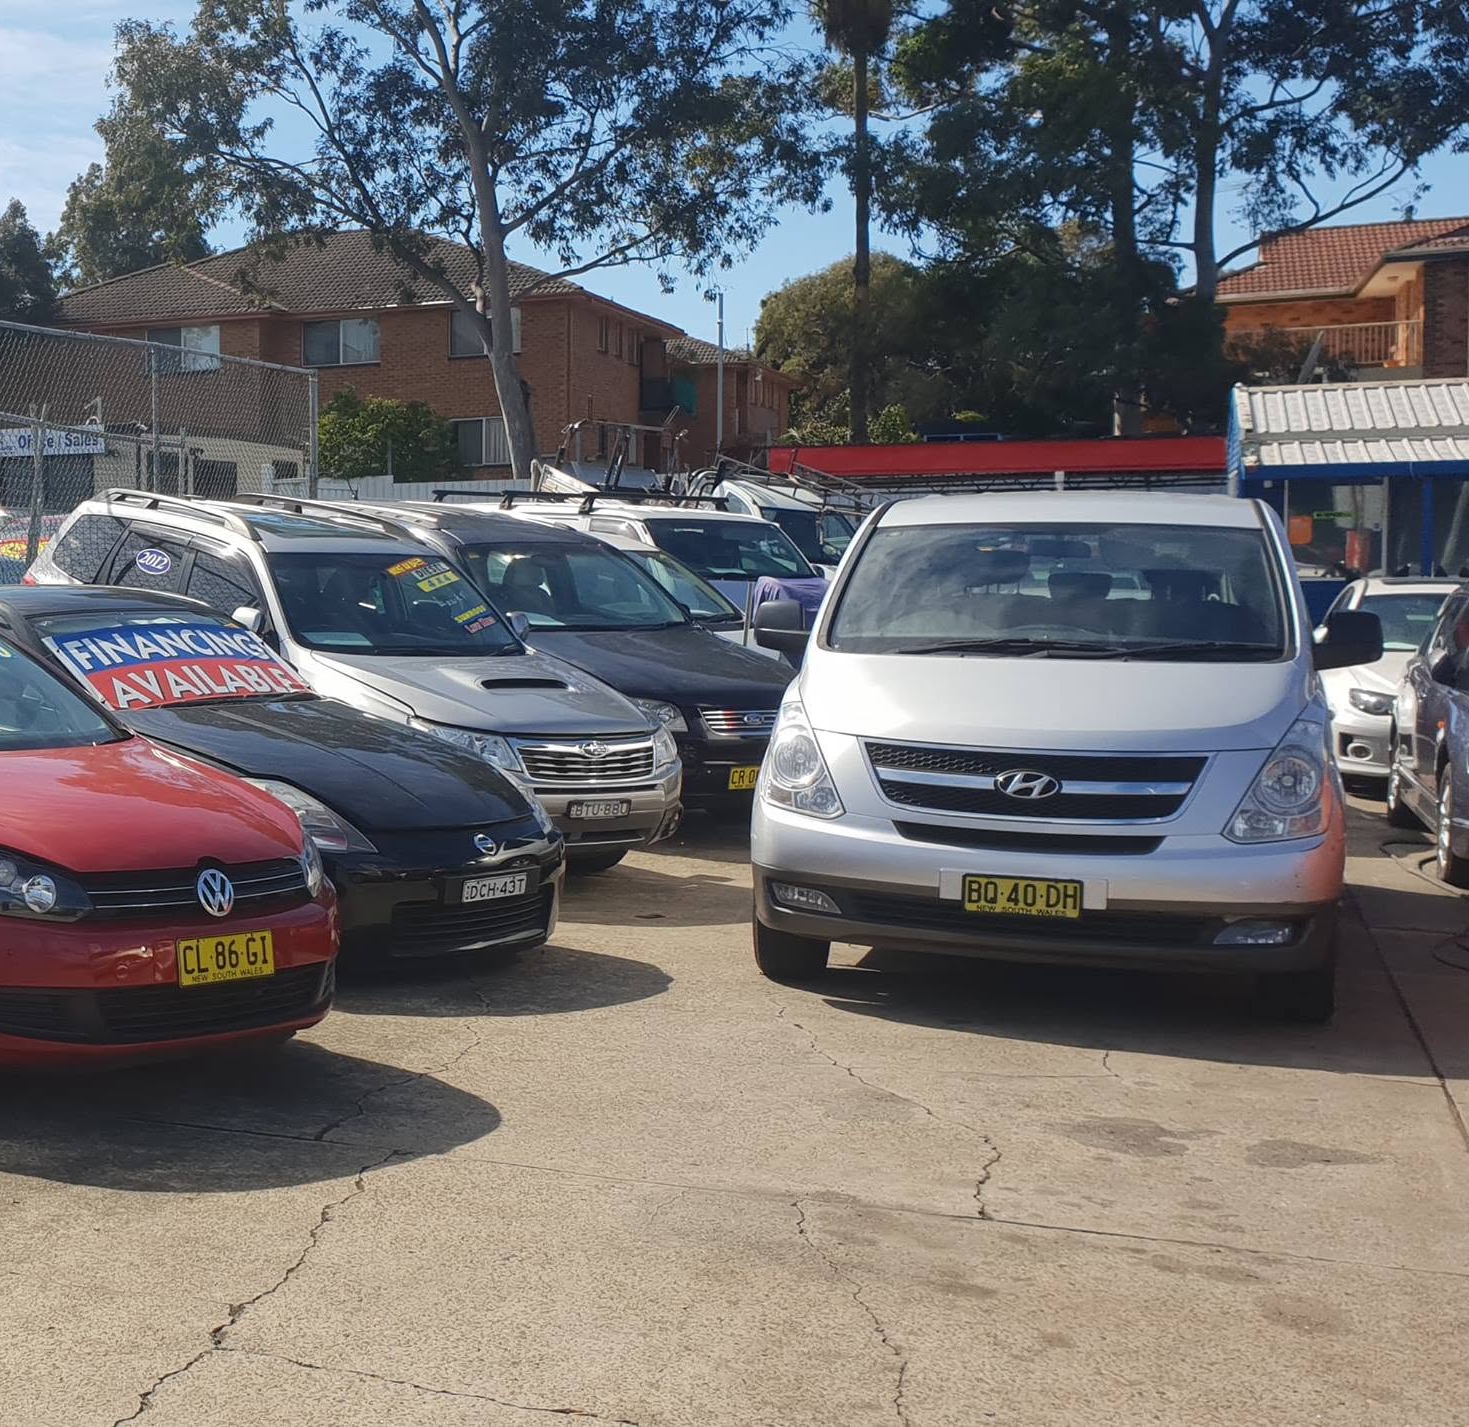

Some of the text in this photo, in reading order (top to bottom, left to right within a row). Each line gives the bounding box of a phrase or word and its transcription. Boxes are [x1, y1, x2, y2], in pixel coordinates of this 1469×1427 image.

[65, 432, 98, 447] Sales
[138, 551, 169, 570] 2012
[415, 562, 447, 579] DIESEL
[63, 629, 270, 670] FINANCING
[111, 664, 293, 709] AVAILABLE
[976, 904, 1067, 917] NEW SOUTH WALES
[192, 966, 264, 982] NEW SOUTH WALES
